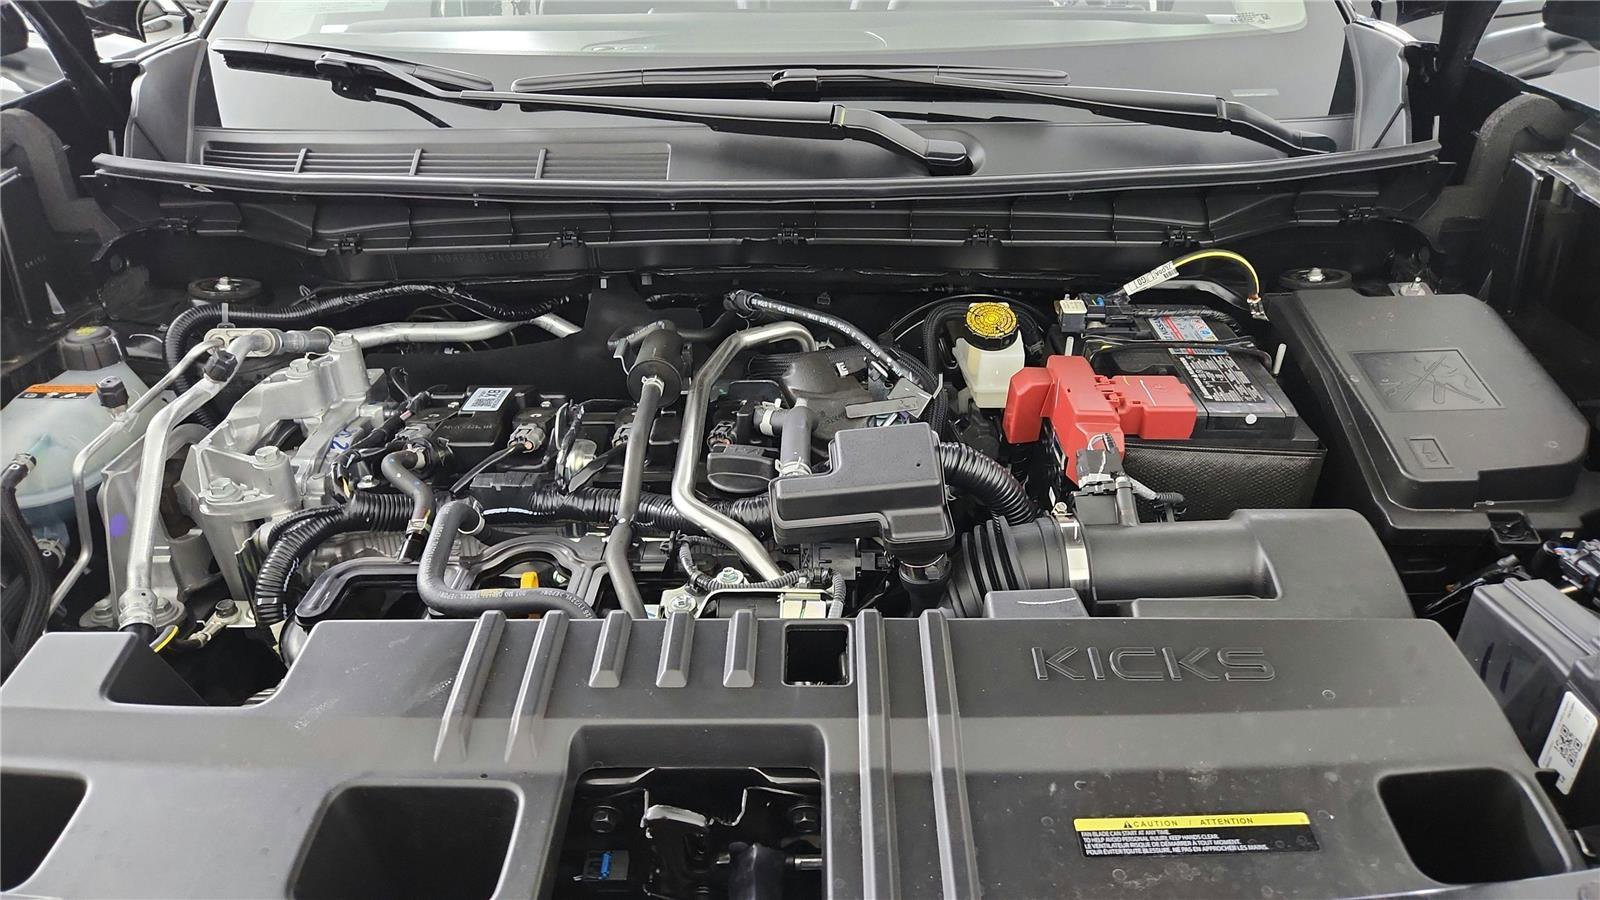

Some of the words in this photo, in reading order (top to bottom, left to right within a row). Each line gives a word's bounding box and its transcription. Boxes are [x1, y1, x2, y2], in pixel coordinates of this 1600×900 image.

[1031, 647, 1276, 681] KICKS
[1132, 820, 1178, 828] CAUTION
[1200, 817, 1254, 826] ATTENTION
